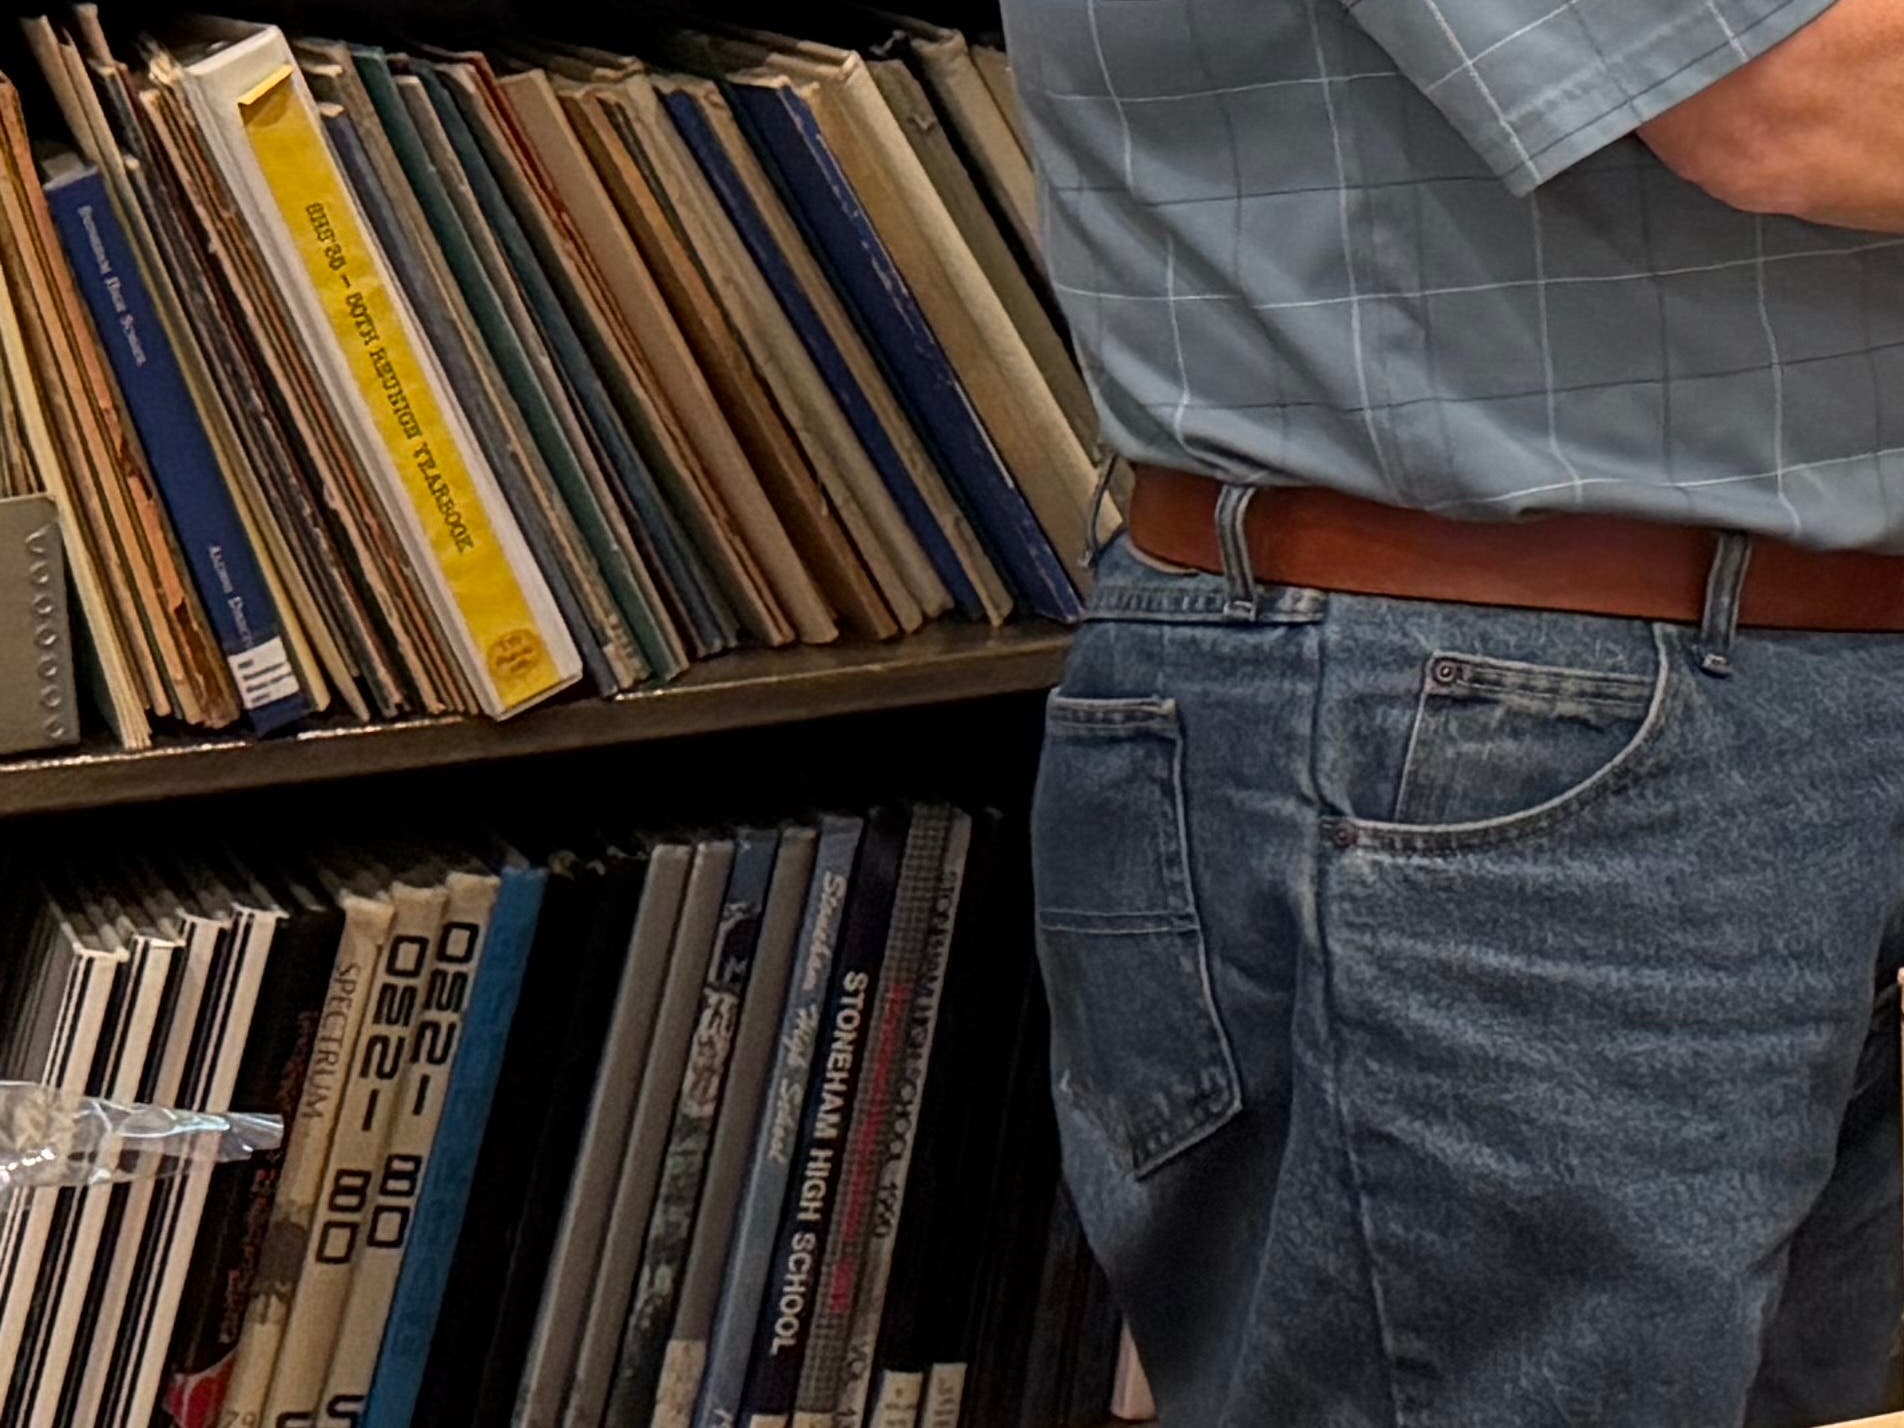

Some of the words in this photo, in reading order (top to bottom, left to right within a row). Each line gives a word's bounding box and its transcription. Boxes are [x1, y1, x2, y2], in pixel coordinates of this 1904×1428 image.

[369, 347, 423, 441] REUNION
[413, 442, 474, 555] YEARBOOK
[301, 962, 361, 1121] SPECTRUM
[784, 1002, 819, 1069] High
[813, 971, 869, 1141] STONEHAM
[768, 1077, 803, 1166] School
[315, 1168, 373, 1265] 80
[366, 1153, 423, 1249] 80
[798, 1147, 834, 1223] HIGH
[768, 1232, 818, 1355] SCHOOL
